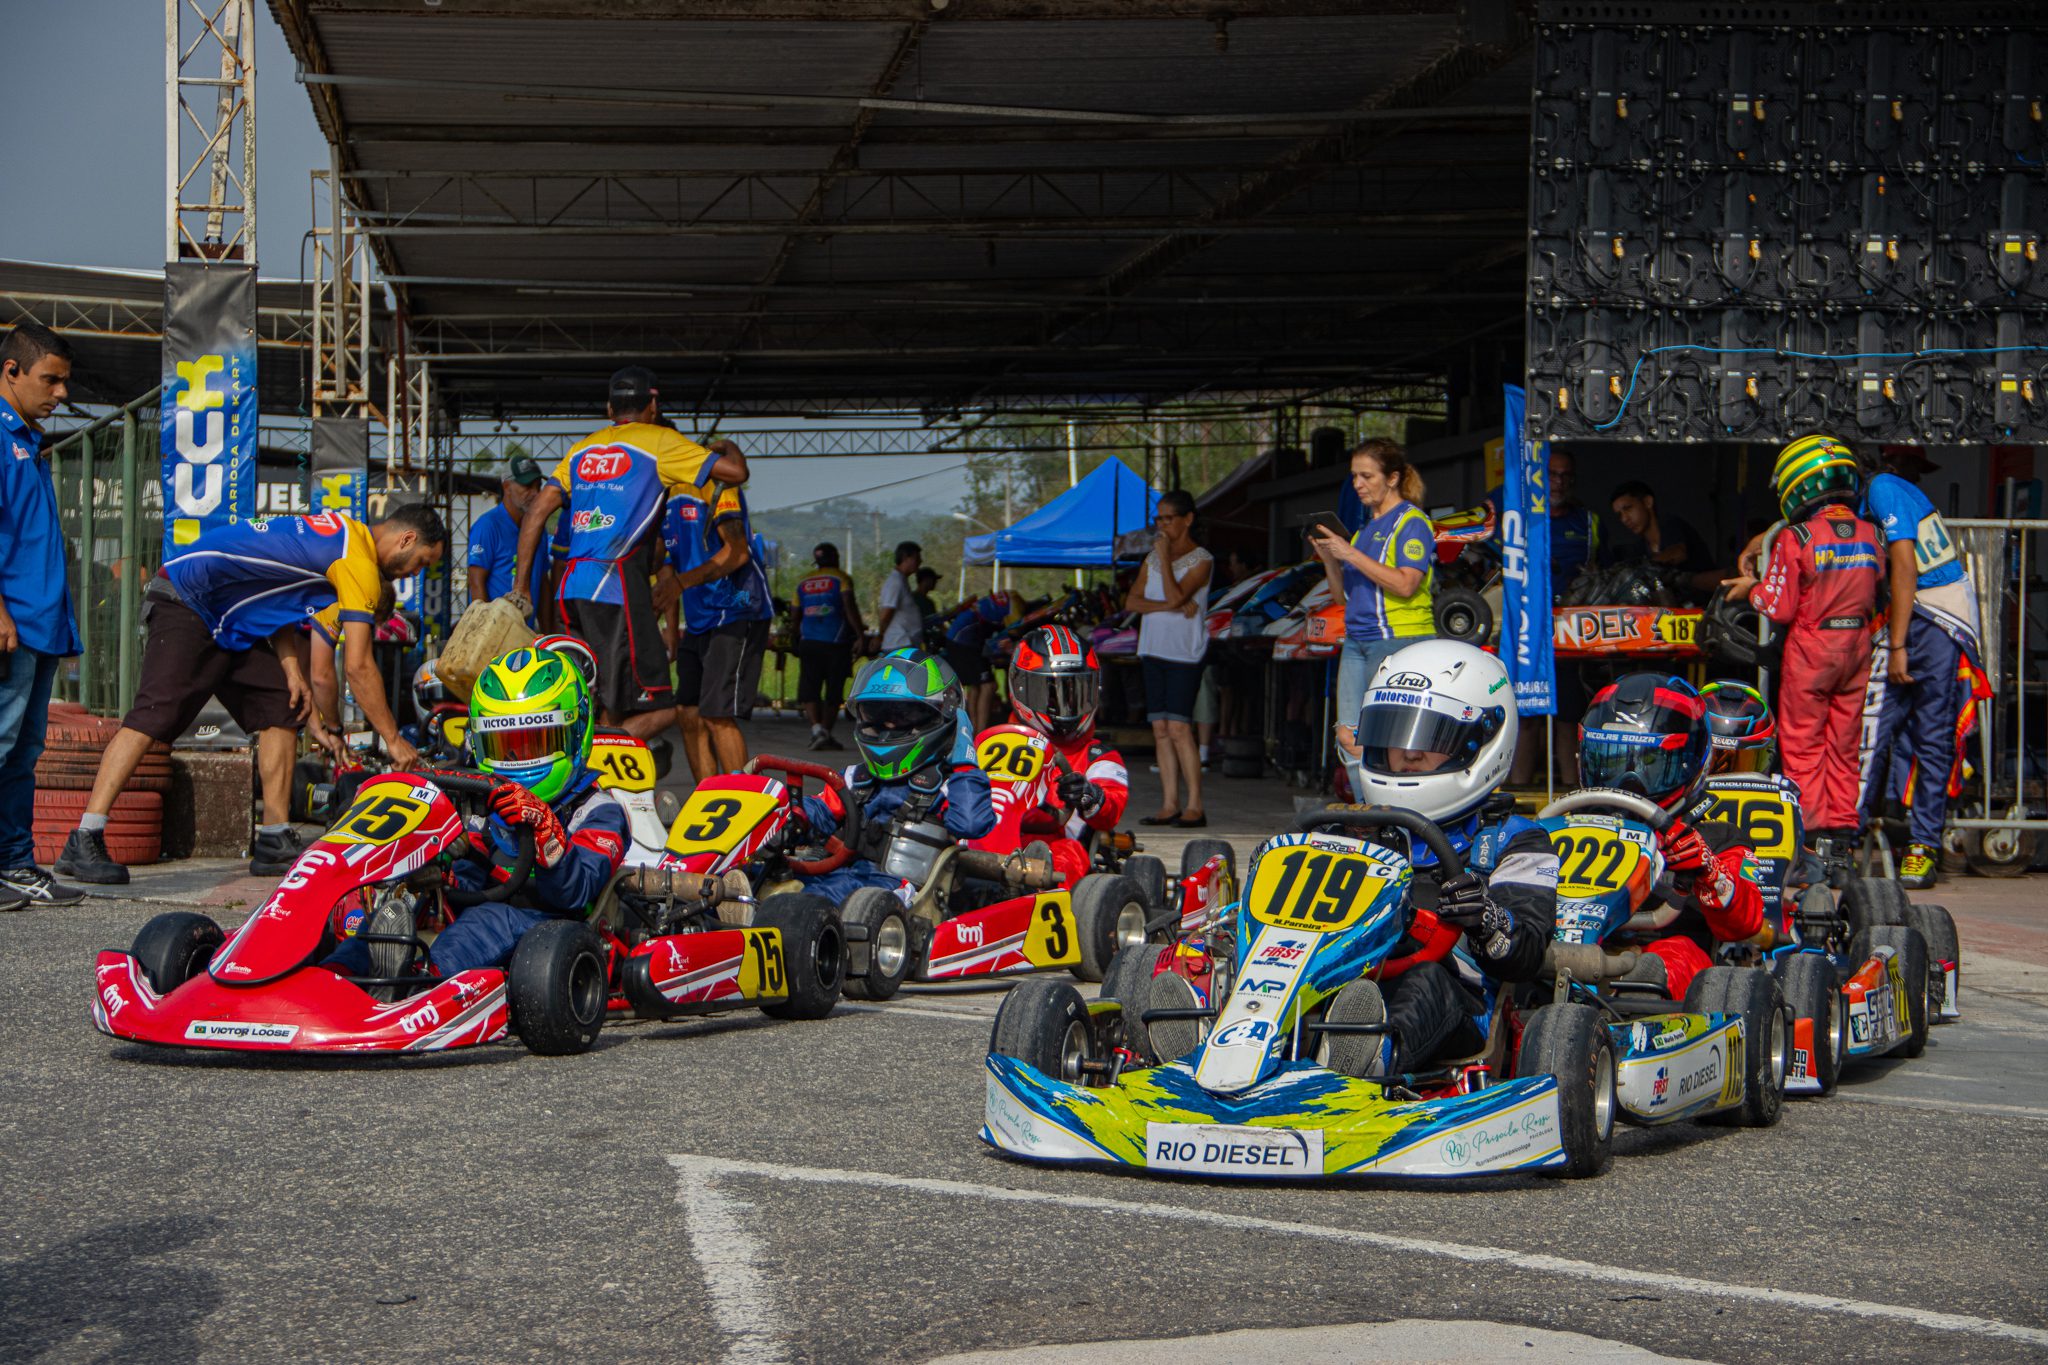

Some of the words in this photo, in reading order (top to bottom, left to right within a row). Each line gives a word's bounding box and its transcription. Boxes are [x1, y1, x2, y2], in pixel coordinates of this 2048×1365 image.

[231, 355, 240, 406] KART
[231, 413, 240, 436] DE
[229, 445, 239, 525] CARIOCA
[1815, 549, 1835, 566] HP
[1554, 608, 1641, 648] NDER
[1392, 673, 1428, 688] Arai
[483, 717, 516, 729] VICTOR
[518, 714, 554, 725] LOOSE
[1586, 731, 1619, 742] NICOLAS
[1621, 734, 1656, 744] SOUZA
[602, 751, 646, 781] 18
[983, 742, 1037, 777] 26
[415, 788, 429, 800] M
[331, 796, 421, 841] 15
[683, 797, 742, 842] 3
[1708, 799, 1785, 847] 46
[1625, 831, 1641, 840] M
[1375, 866, 1392, 876] C
[1553, 835, 1626, 889] 222
[1264, 850, 1369, 924] 119
[1040, 901, 1069, 960] 3
[1273, 917, 1322, 931] M.Parreira
[749, 931, 783, 991] 15
[1260, 946, 1305, 960] FIRST
[210, 1026, 250, 1036] VICTOR
[251, 1028, 290, 1037] LOOSE
[399, 1000, 440, 1034] tmj
[1652, 1078, 1670, 1095] FIRST
[1678, 1075, 1694, 1097] RIO
[1693, 1064, 1718, 1090] DIESEL
[1155, 1141, 1197, 1162] RIO
[1203, 1143, 1294, 1166] DIESEL
